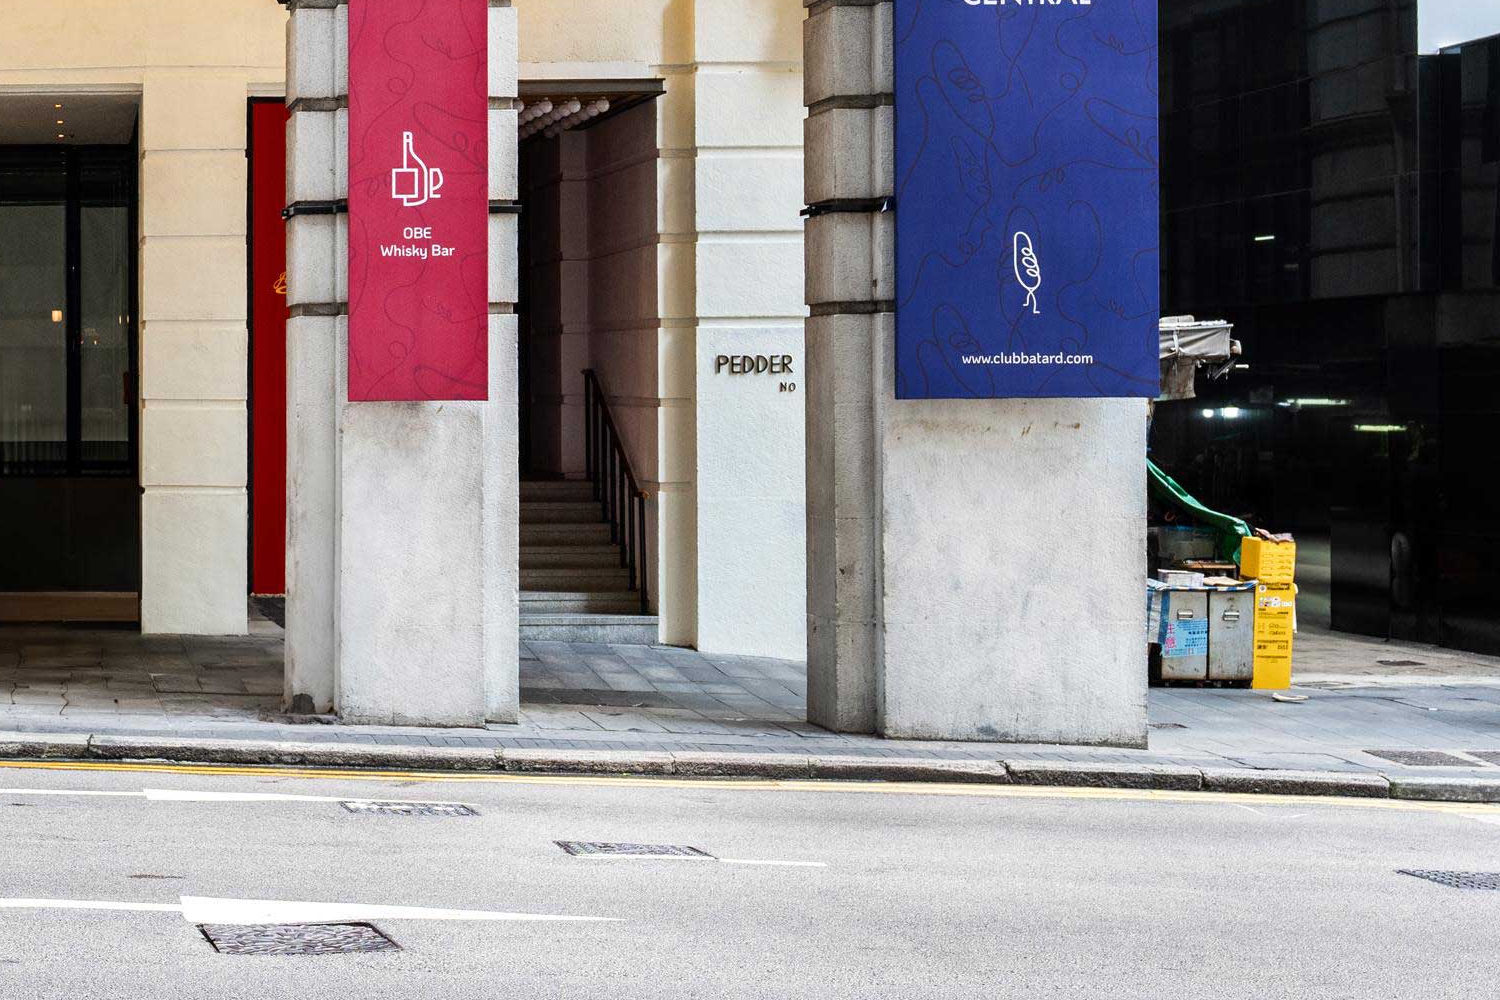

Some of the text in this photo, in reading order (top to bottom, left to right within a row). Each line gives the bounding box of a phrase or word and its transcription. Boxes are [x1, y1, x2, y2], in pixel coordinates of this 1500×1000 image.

[403, 226, 432, 240] OBE
[380, 244, 456, 260] Whisky Bar
[715, 354, 794, 375] PEDDER
[961, 351, 1093, 366] www.clubbatard.com
[780, 381, 797, 393] NO
